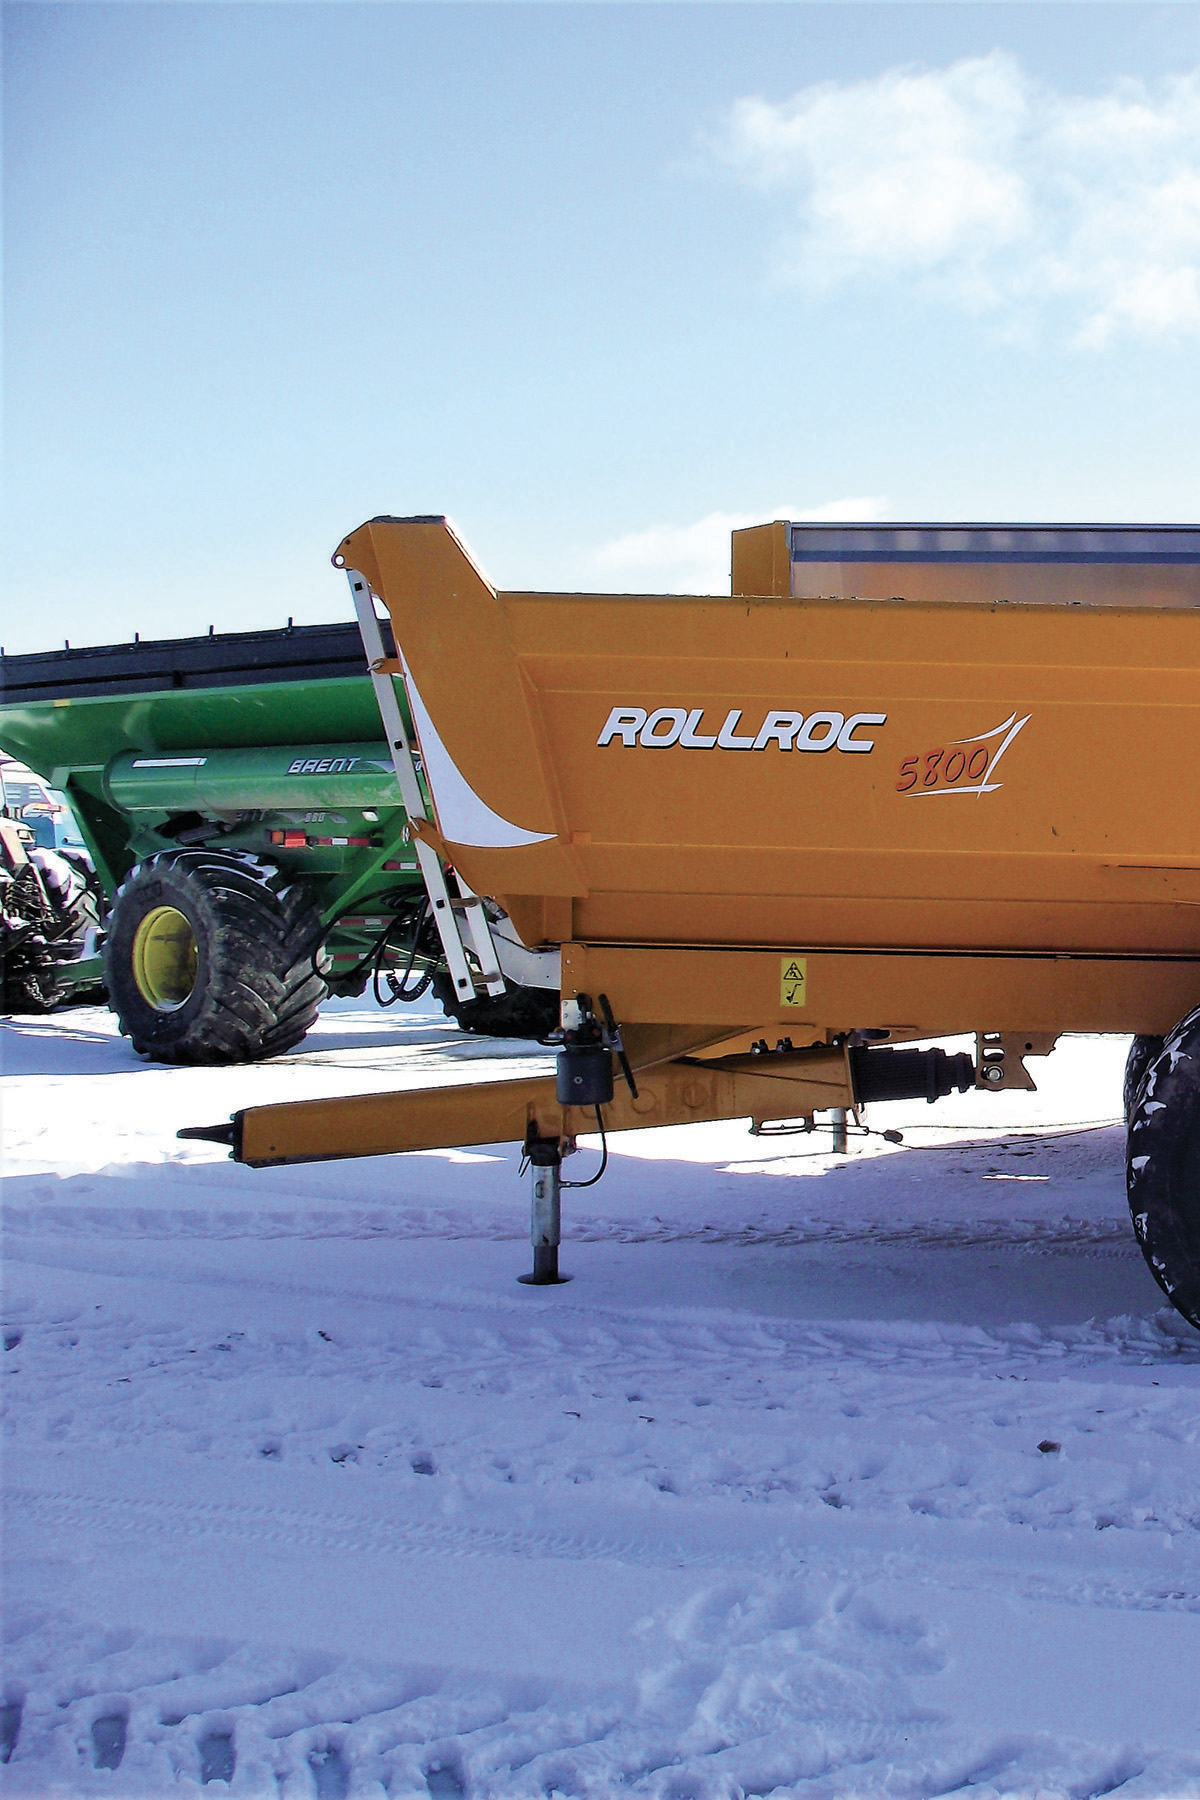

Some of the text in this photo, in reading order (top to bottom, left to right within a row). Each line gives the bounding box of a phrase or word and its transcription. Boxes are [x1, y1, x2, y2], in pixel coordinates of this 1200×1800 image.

[287, 757, 361, 774] BRENT
[596, 707, 990, 792] ROLLROC 5800
